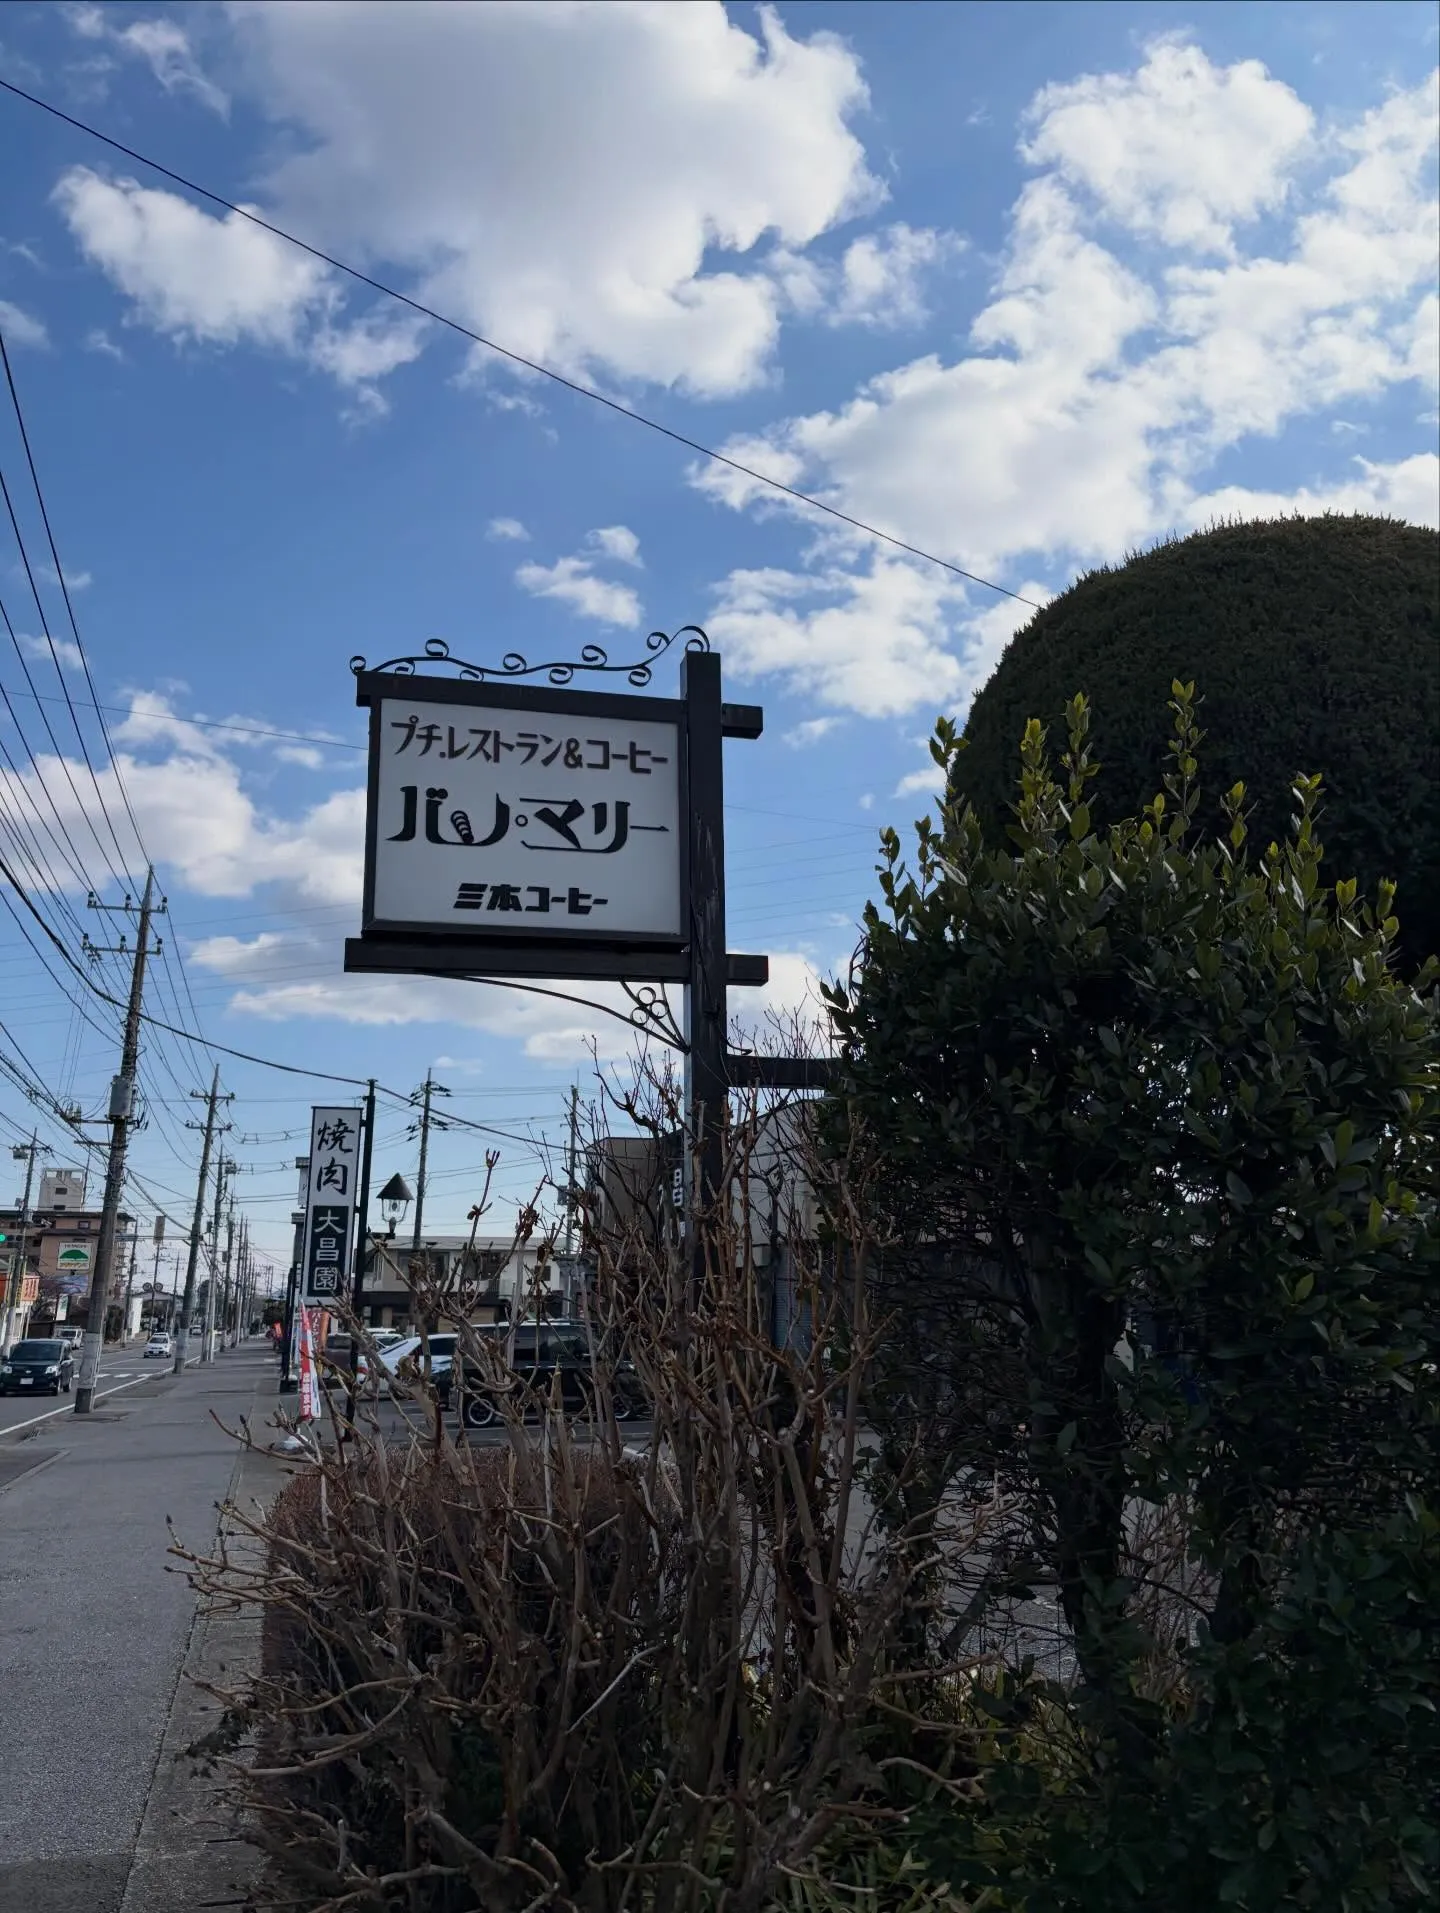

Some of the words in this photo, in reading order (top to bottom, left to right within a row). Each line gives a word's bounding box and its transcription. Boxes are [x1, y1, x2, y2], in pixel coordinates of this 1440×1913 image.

[453, 882, 609, 915] 三本コーヒー
[317, 1118, 354, 1195] 焼肉
[313, 1208, 346, 1291] 大昌園
